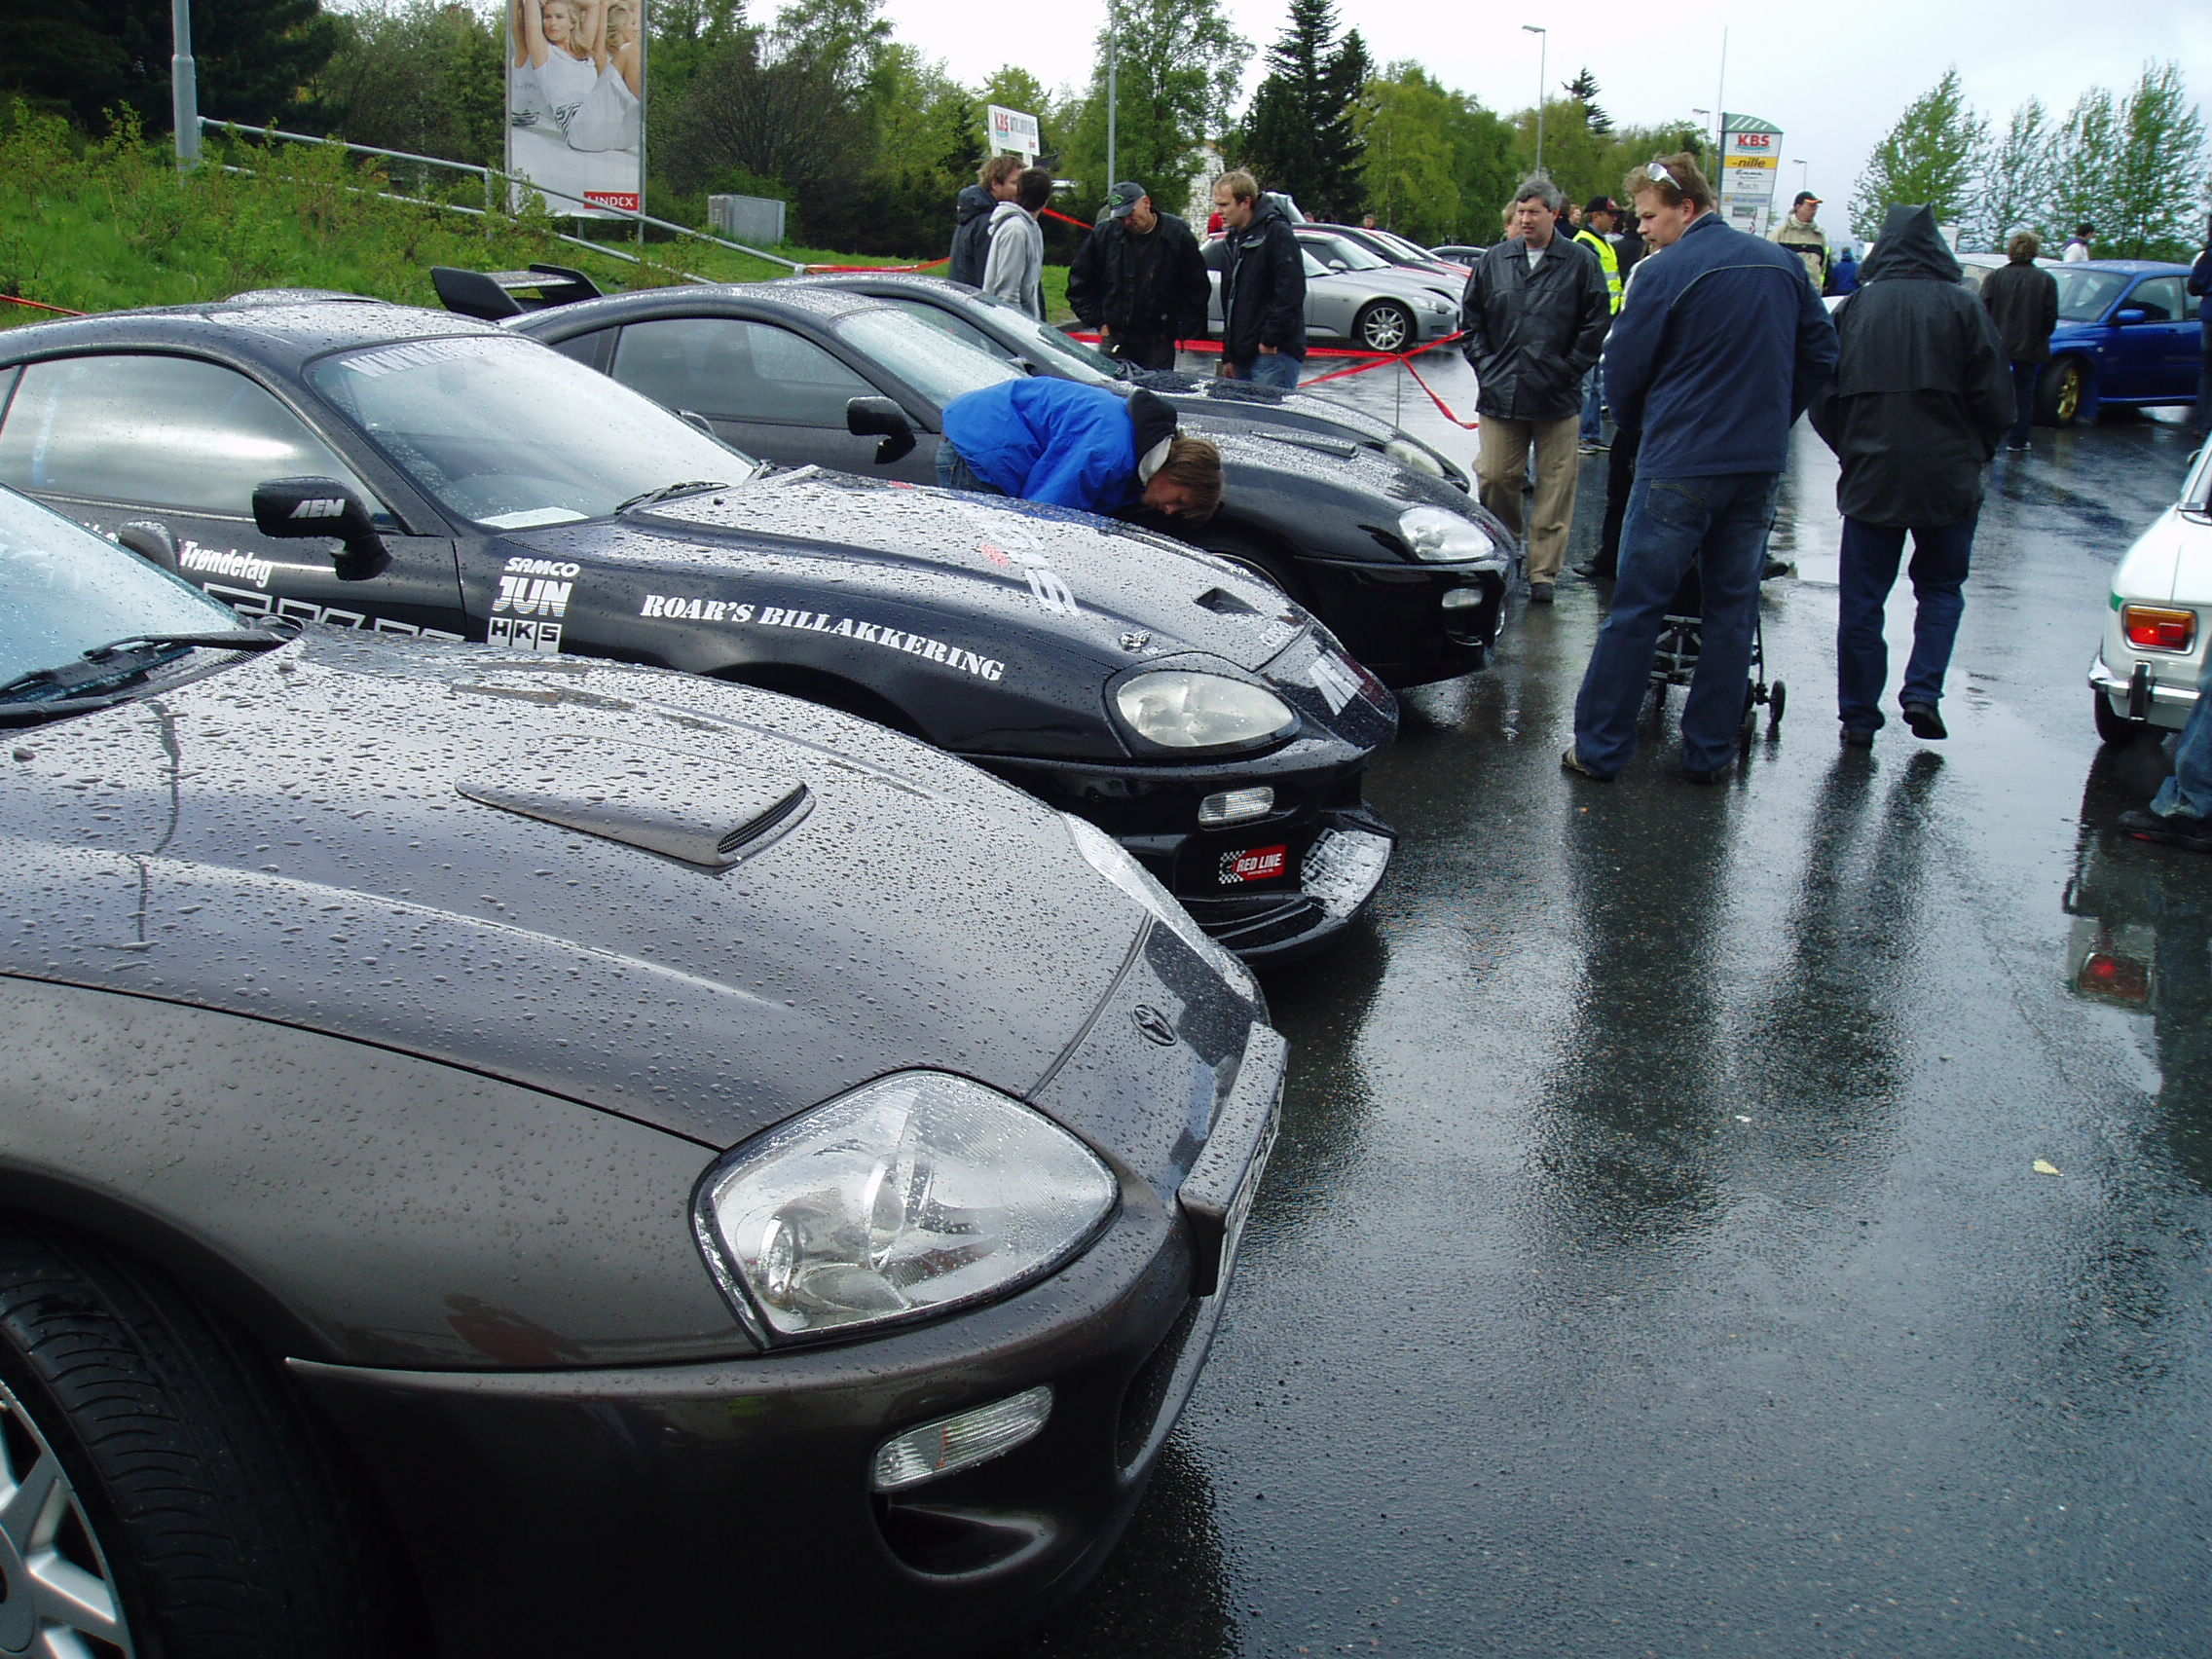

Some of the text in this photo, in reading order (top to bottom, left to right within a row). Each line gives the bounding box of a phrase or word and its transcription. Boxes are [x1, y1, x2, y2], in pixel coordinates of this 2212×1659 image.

[1737, 134, 1770, 147] KBS
[288, 499, 346, 519] AEM
[179, 539, 274, 589] Trøndelag
[504, 557, 580, 577] SAMCO
[492, 575, 572, 617] JUN
[489, 617, 562, 645] HKS
[640, 594, 1005, 682] ROAR'S BILLAKKERING
[1236, 857, 1258, 873] RED
[1258, 853, 1282, 869] LINE
